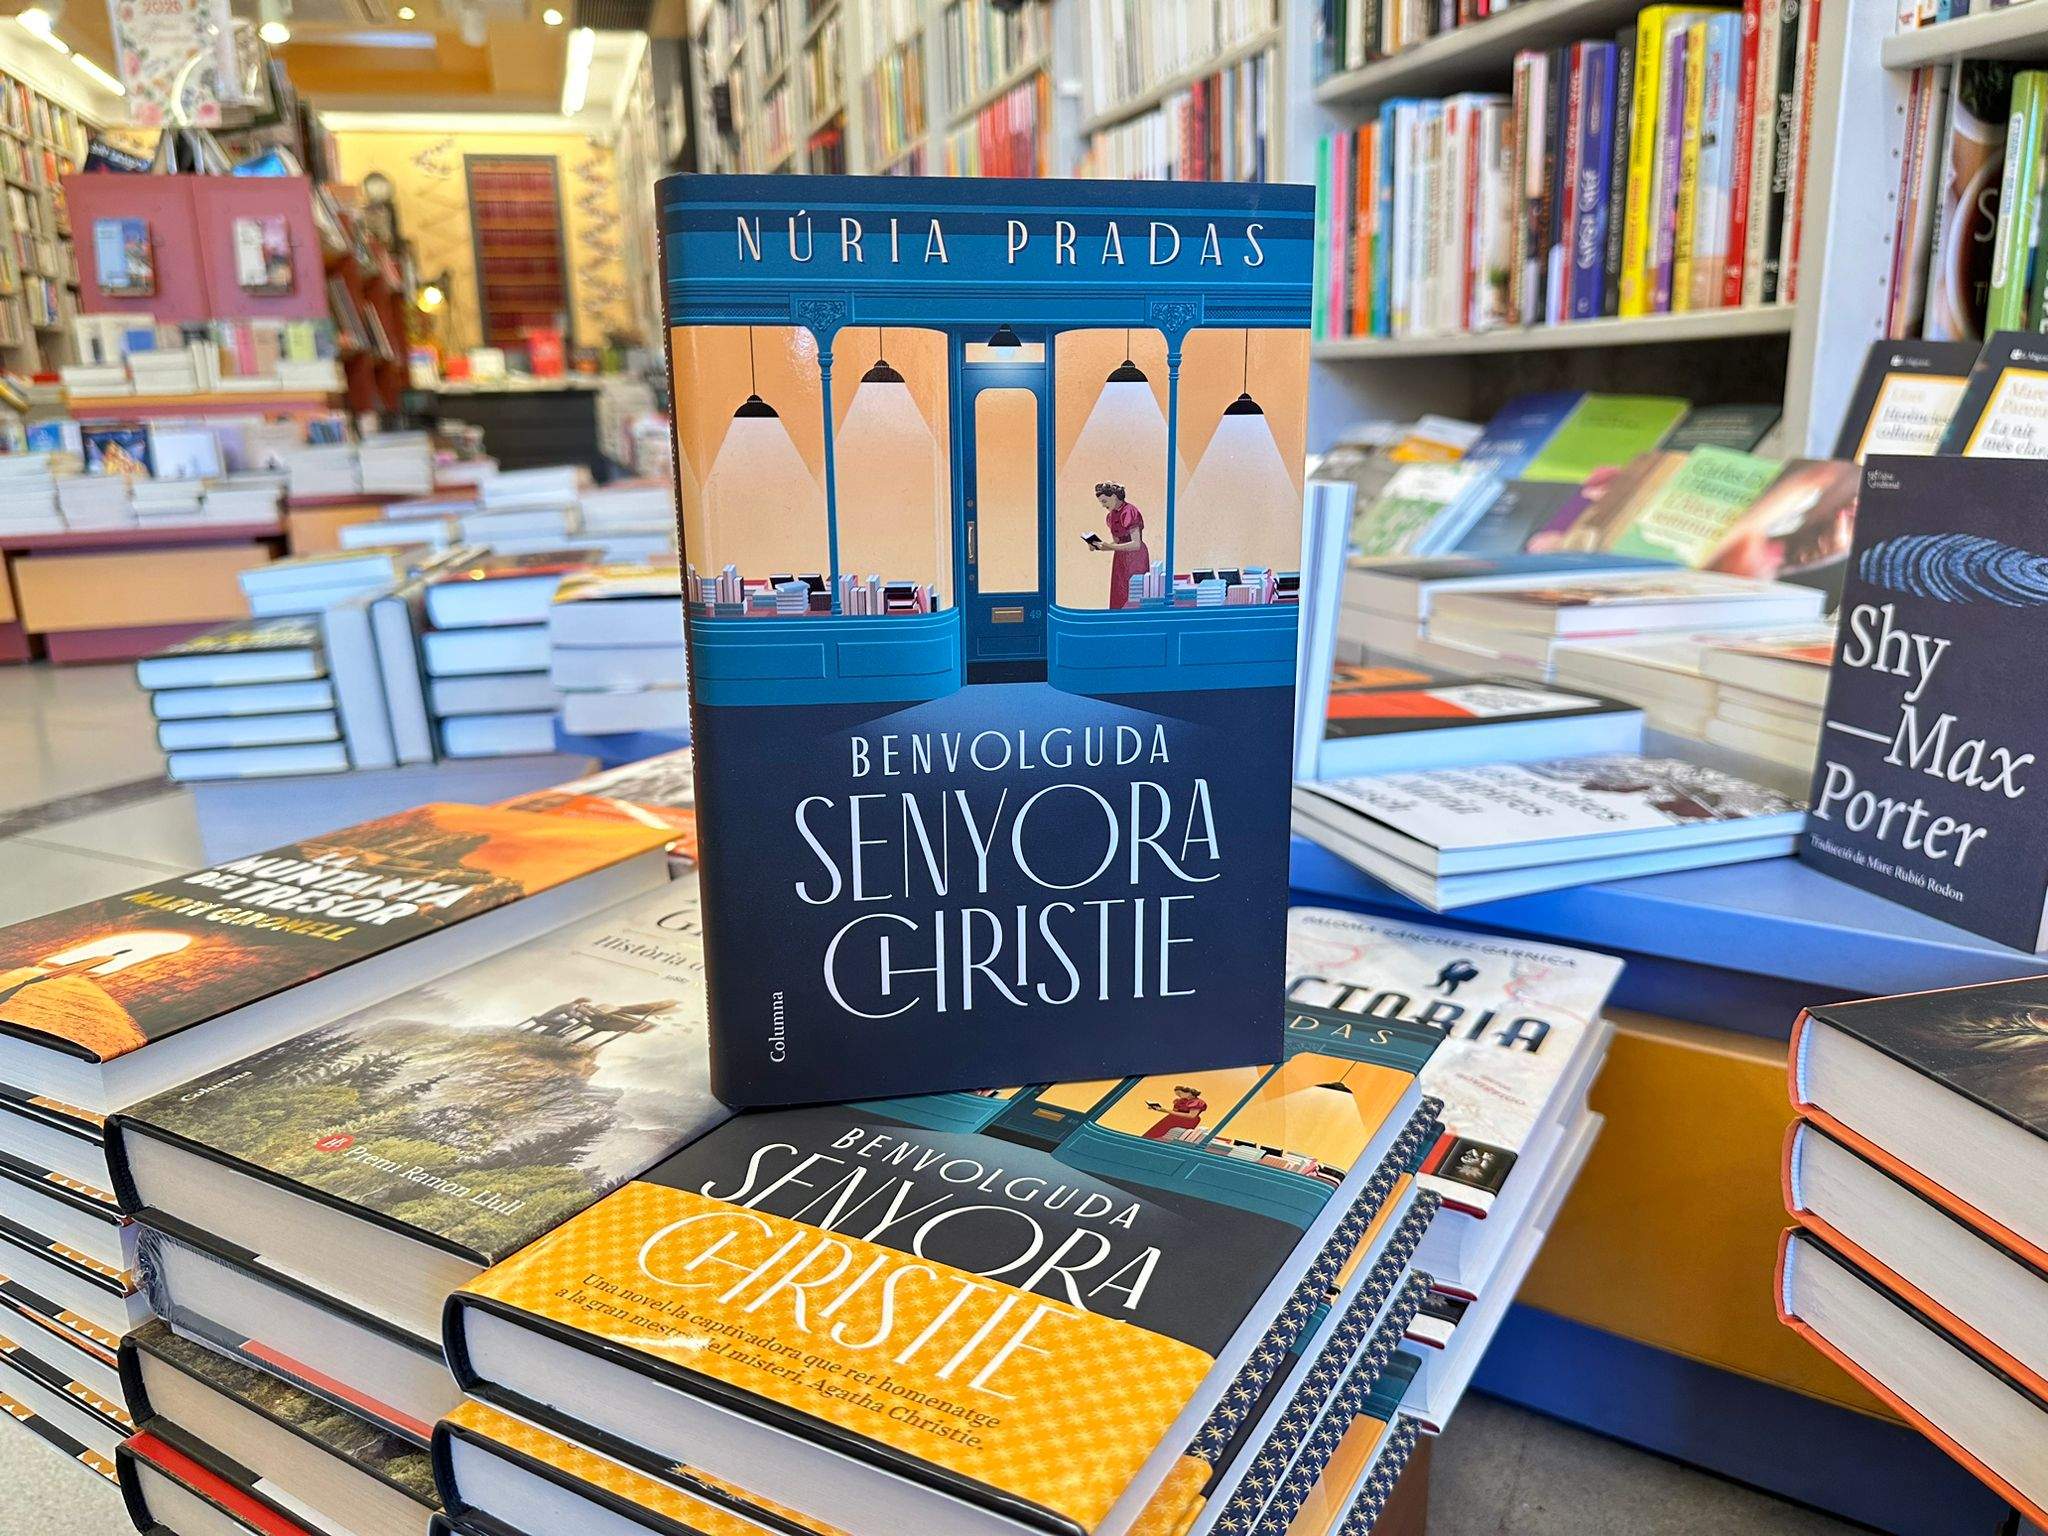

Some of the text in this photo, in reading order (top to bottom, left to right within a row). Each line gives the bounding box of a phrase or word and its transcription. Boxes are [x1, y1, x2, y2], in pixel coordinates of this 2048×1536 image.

[737, 209, 1265, 267] NÚRIA PRADAS
[1842, 602, 1951, 702] Shy
[851, 724, 1170, 777] BENVOLGUDA
[795, 778, 1221, 905] SENYORA
[1812, 760, 1987, 868] Porter
[219, 854, 474, 909] MUNTANYA
[310, 851, 358, 868] LA
[1810, 833, 1964, 902] Traducció de Marc Rubió Rodon
[183, 870, 420, 926] DEL TRESOR
[823, 895, 1196, 1019] CHRISTIE
[768, 990, 786, 1063] Columna
[1286, 976, 1551, 1053] CTORIA
[1289, 1015, 1394, 1045] DAS
[181, 1071, 253, 1102] Columna
[344, 1144, 527, 1217] Premi Ramon Llull
[830, 1127, 1141, 1229] BENVOLGUDA
[700, 1143, 1162, 1323] SENYORA
[638, 1211, 1081, 1400] CHRISTIE
[555, 1287, 569, 1299] a
[571, 1290, 587, 1307] la
[581, 1299, 630, 1321] gran
[728, 1348, 803, 1385] misteri,
[805, 1378, 885, 1412] Agatha
[887, 1405, 984, 1450] Christie.
[582, 1273, 1001, 1429] Una novel·la captivadora que ret homenatge
